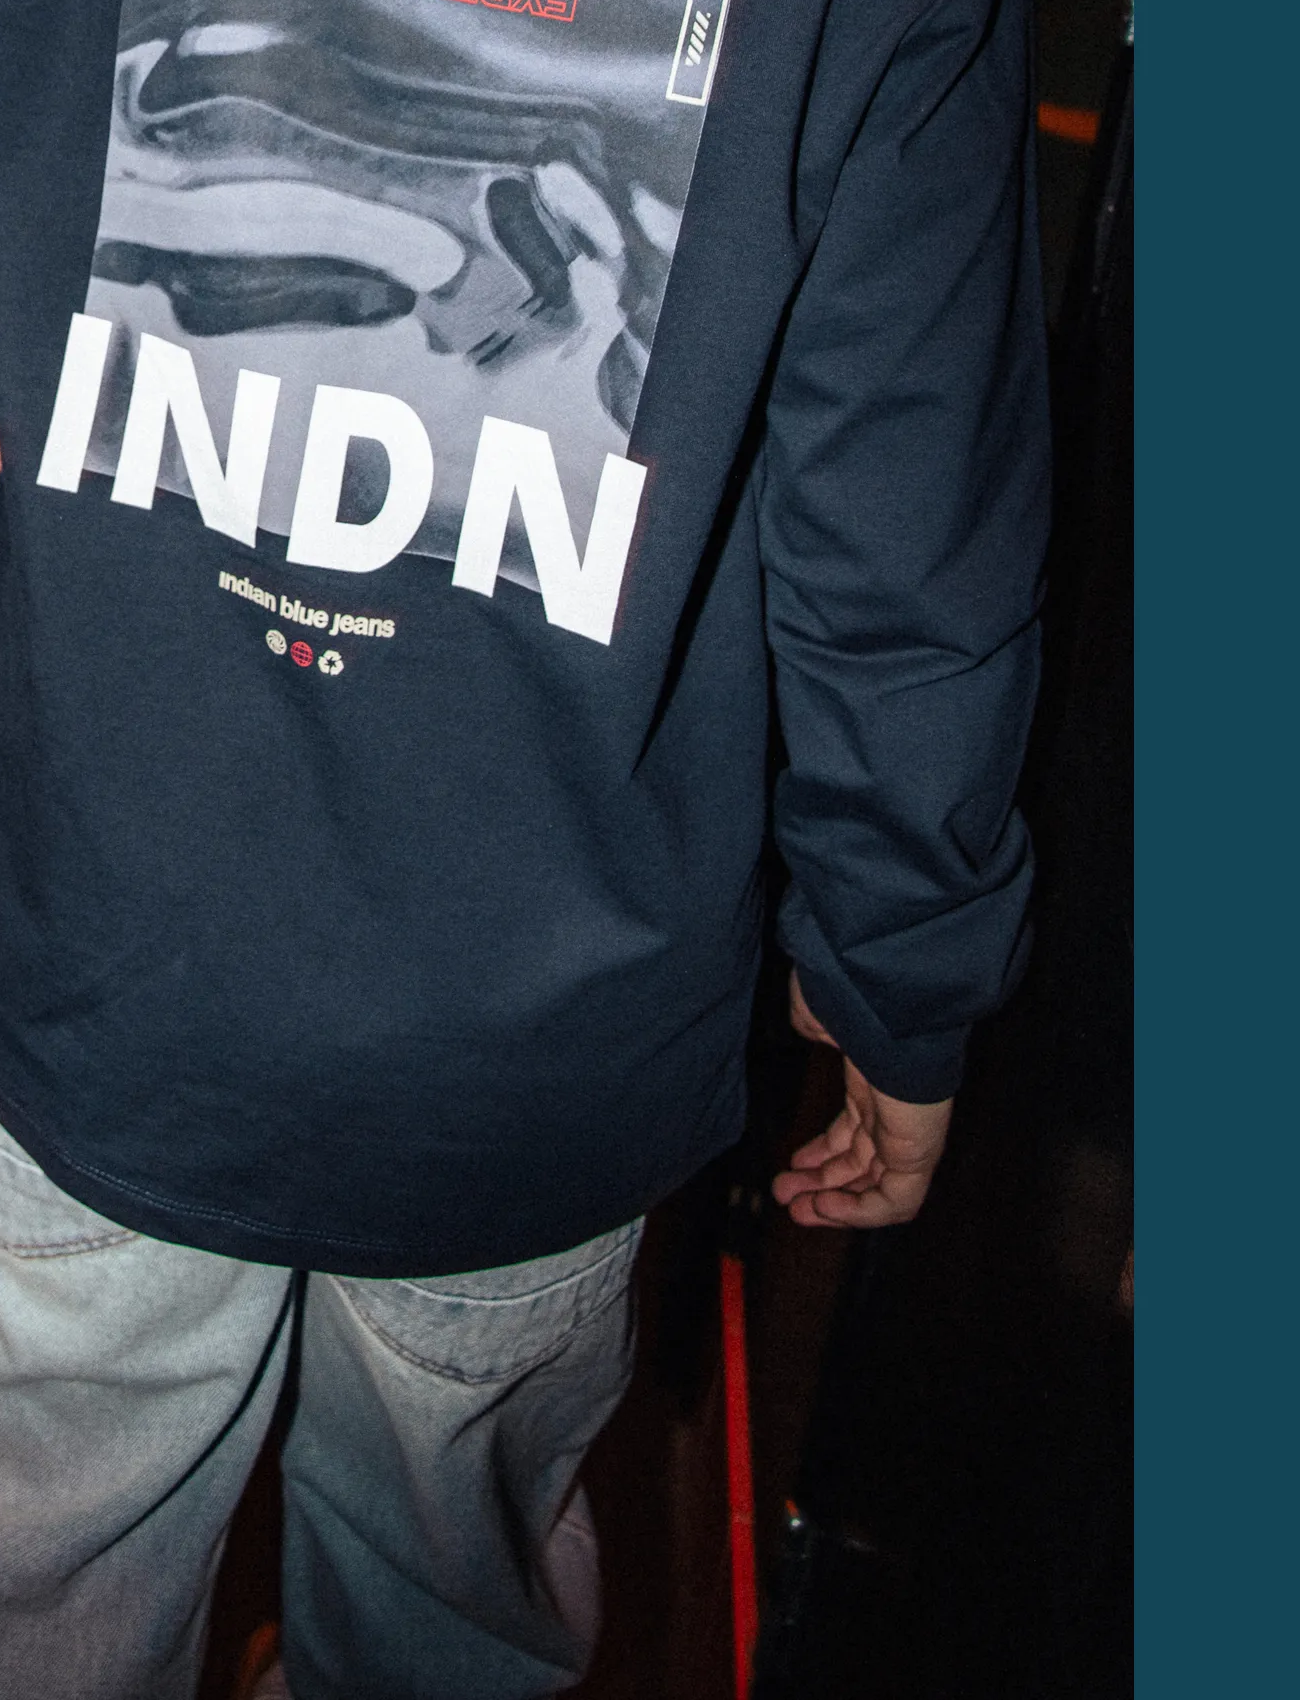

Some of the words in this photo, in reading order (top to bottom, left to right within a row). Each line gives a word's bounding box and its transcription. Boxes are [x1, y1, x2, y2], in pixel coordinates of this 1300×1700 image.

[36, 312, 648, 646] INDN
[279, 595, 330, 629] blue
[328, 613, 396, 638] jeans
